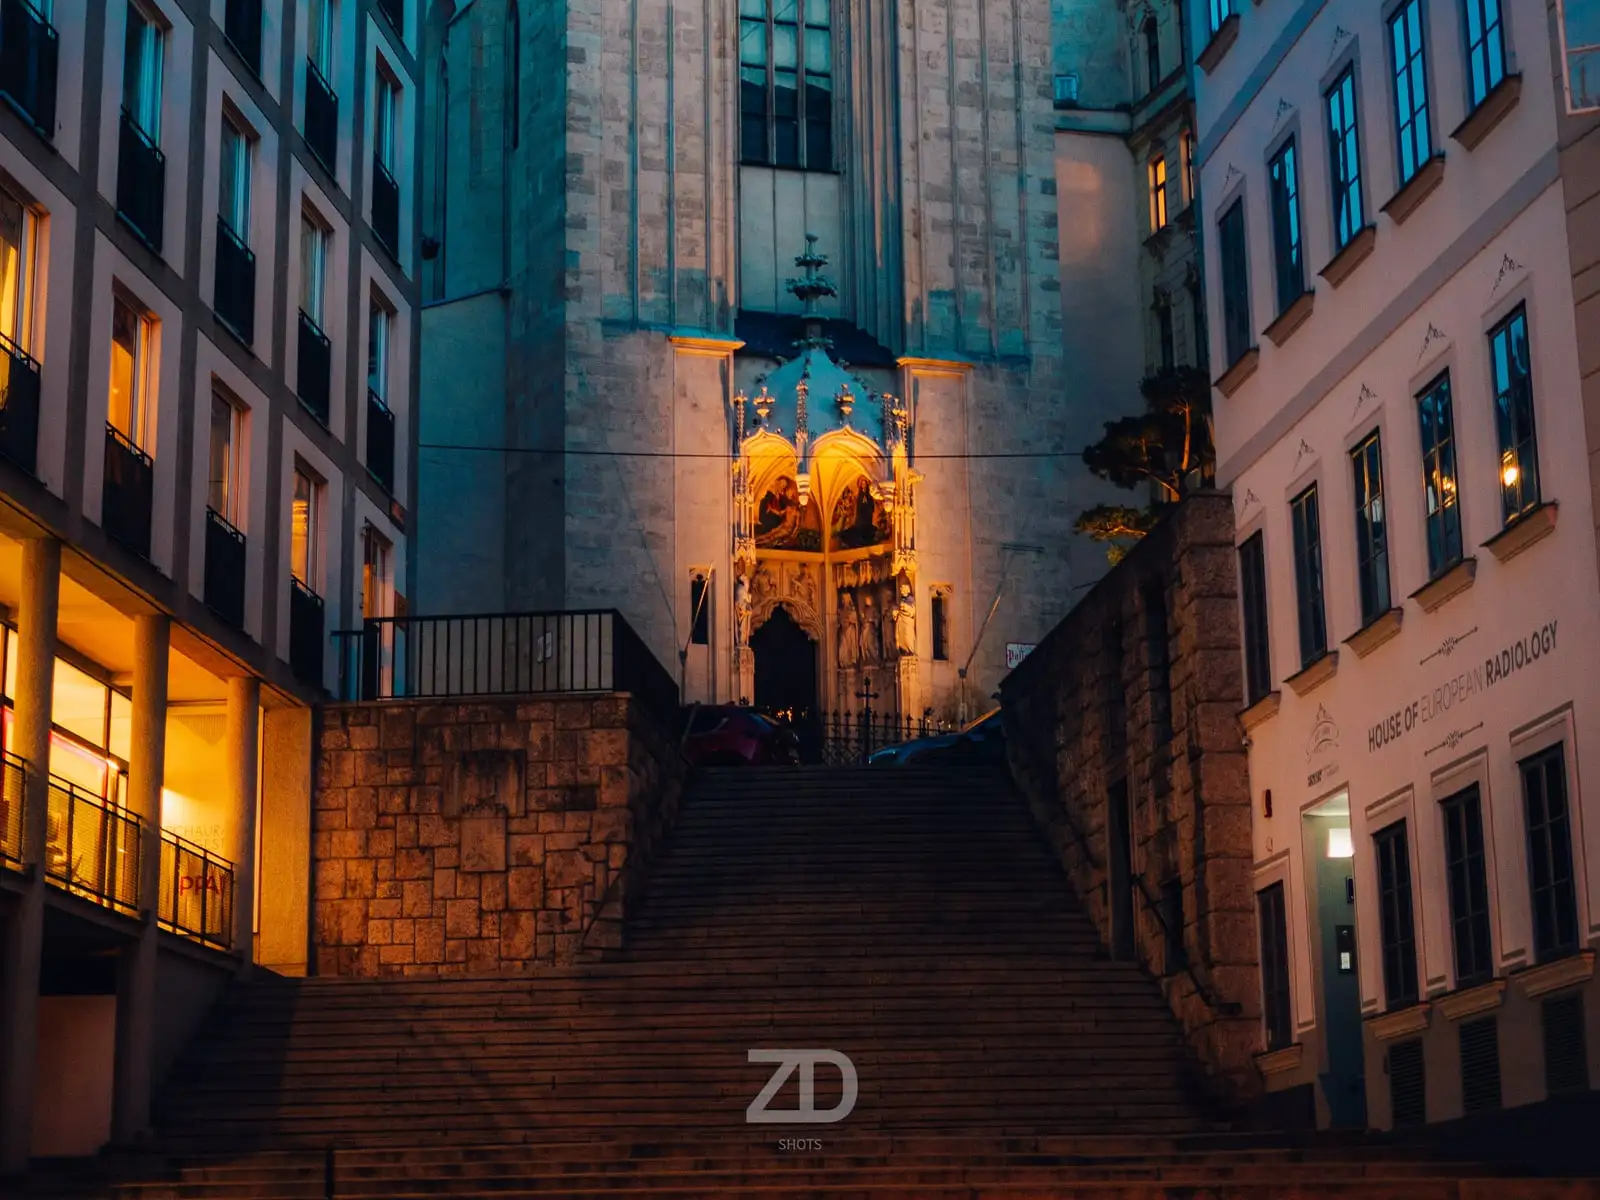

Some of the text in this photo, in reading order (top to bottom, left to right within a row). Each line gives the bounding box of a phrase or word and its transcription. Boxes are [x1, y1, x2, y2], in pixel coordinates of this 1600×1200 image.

[1368, 712, 1402, 753] HOUSE
[1404, 701, 1418, 732] OF
[1421, 666, 1483, 723] EUROPEAN
[1485, 620, 1558, 688] RADIOLOGY
